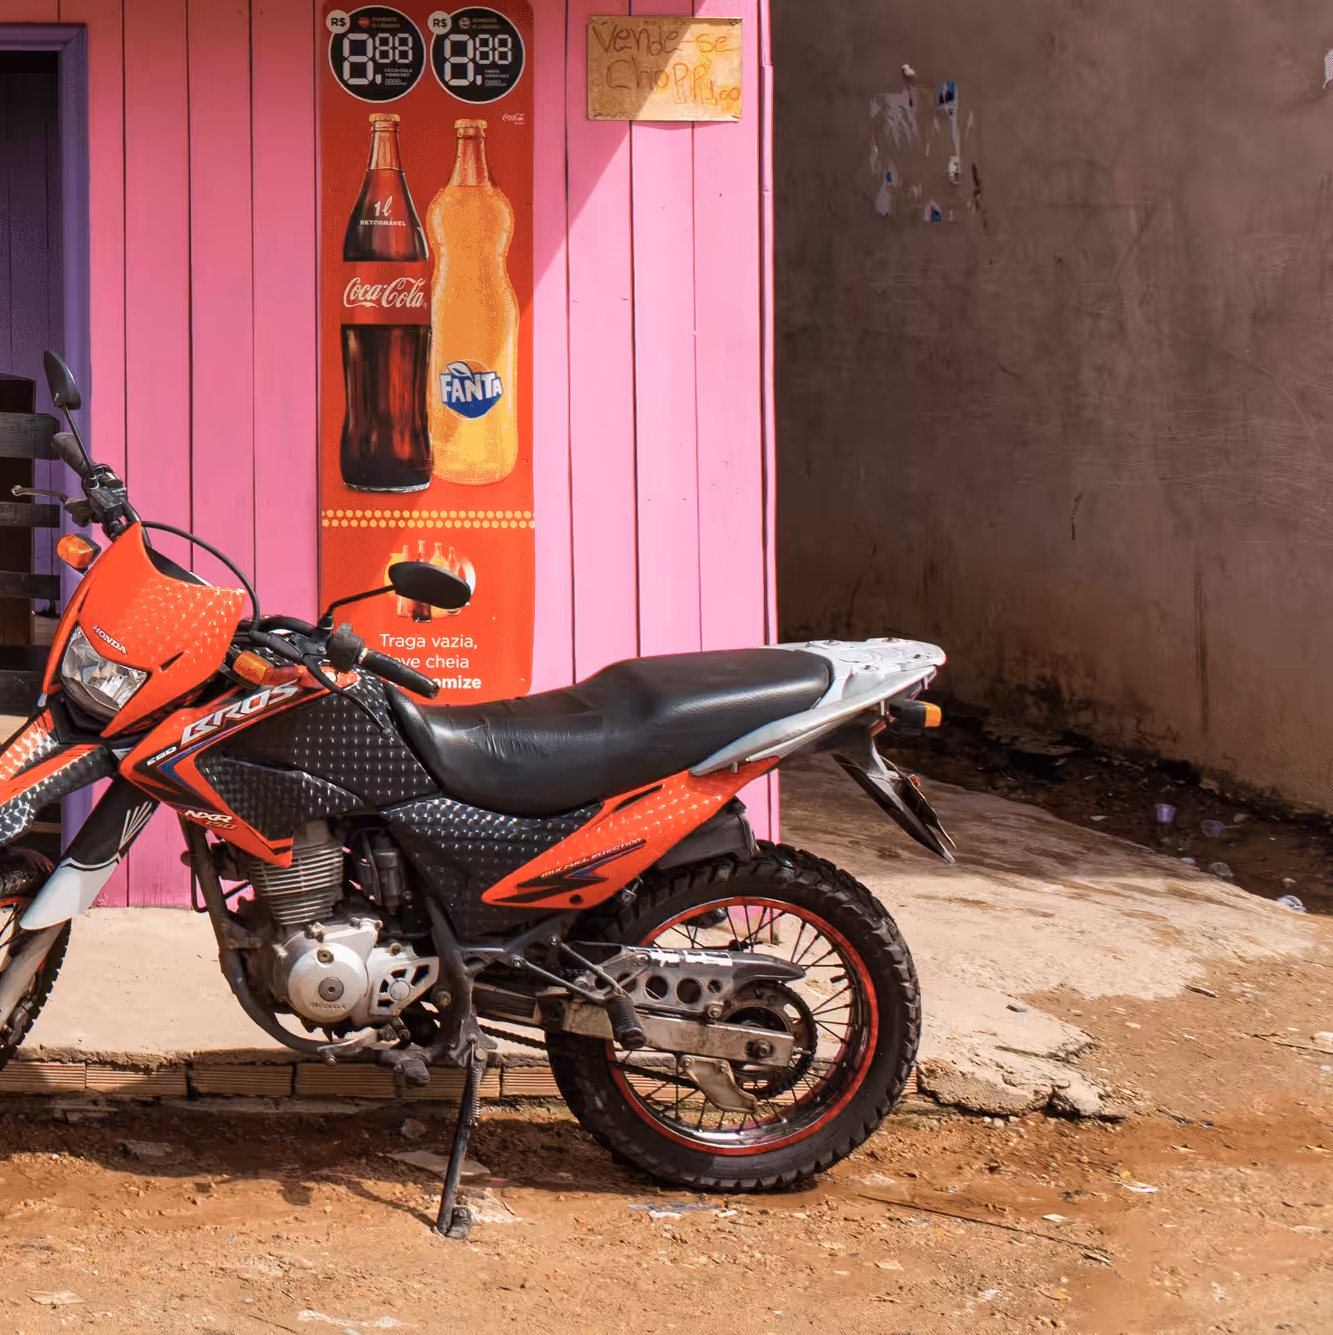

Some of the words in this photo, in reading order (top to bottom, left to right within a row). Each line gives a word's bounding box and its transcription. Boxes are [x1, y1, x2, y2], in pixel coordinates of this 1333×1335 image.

[331, 17, 346, 28] R$
[433, 18, 447, 29] R$
[592, 25, 737, 56] Vende-se
[343, 277, 426, 308] Coca-Cola
[439, 371, 503, 403] FANTA
[93, 625, 127, 656] HONDA
[379, 633, 426, 650] Traga
[431, 634, 478, 650] vazia,
[426, 654, 469, 668] cheia
[181, 678, 301, 745] BROS
[147, 746, 177, 766] ESD
[184, 810, 232, 823] NXR
[541, 867, 562, 878] MIX
[310, 1002, 347, 1010] HONDA
